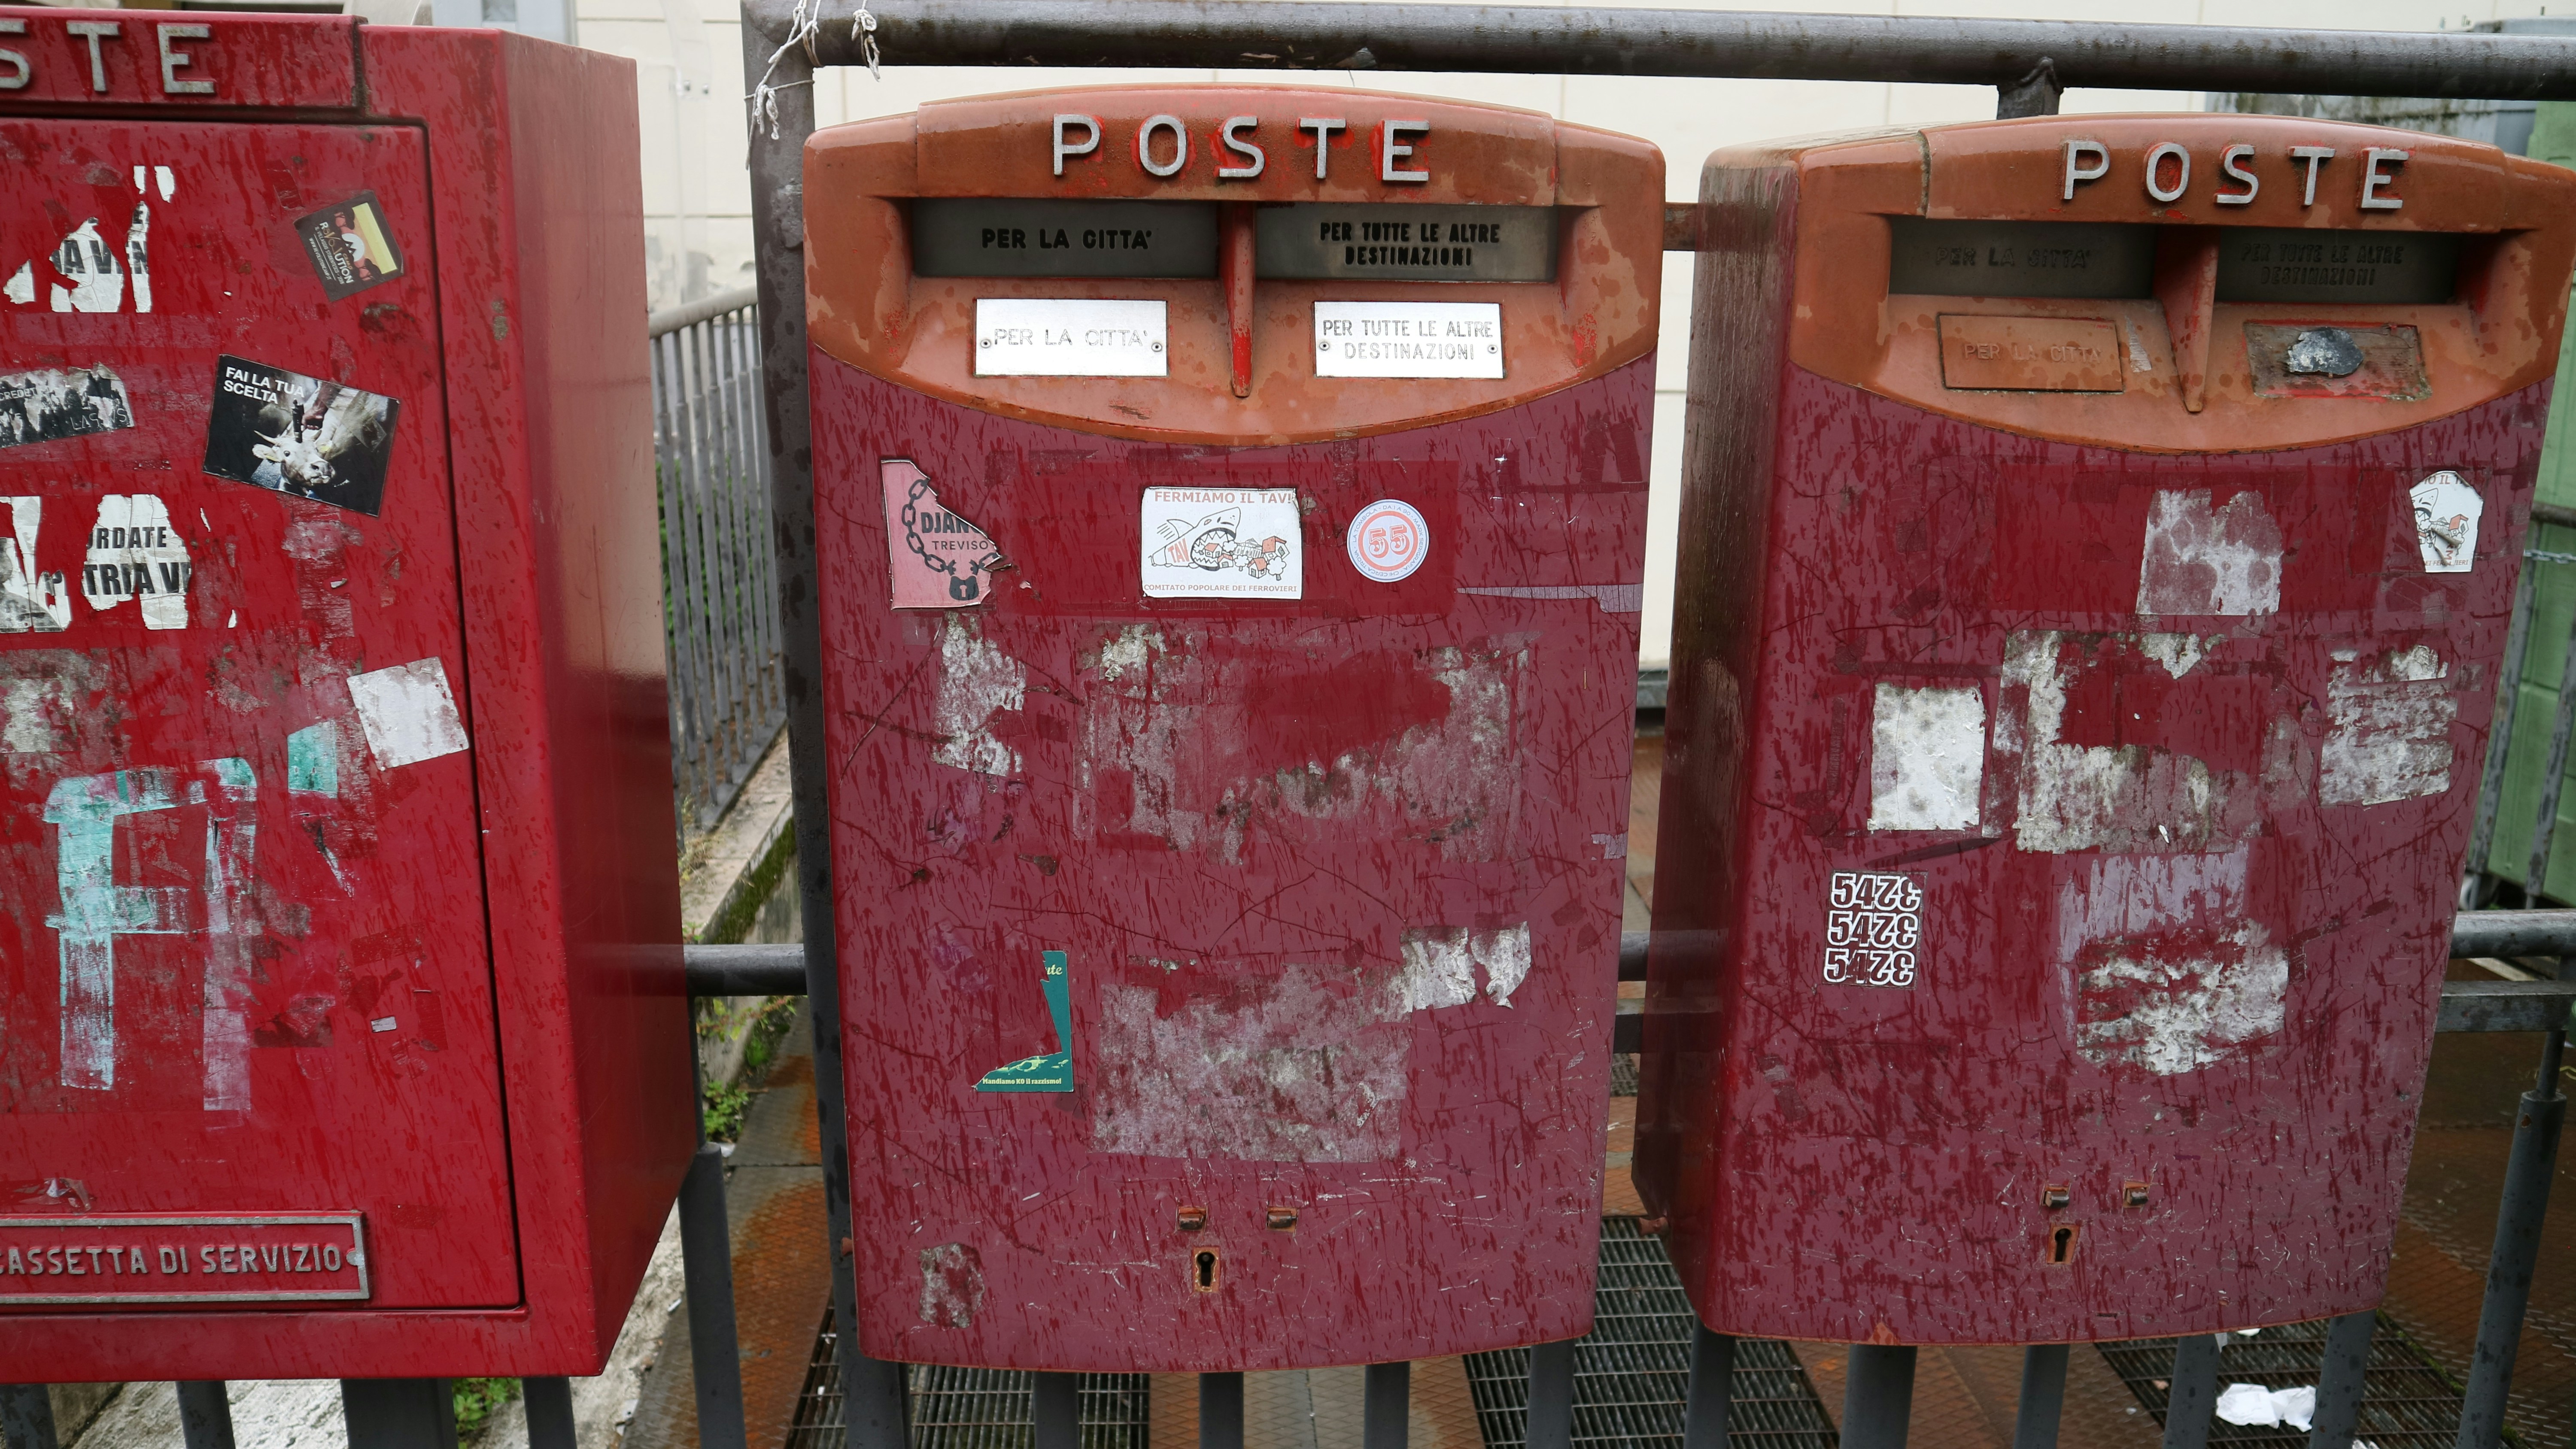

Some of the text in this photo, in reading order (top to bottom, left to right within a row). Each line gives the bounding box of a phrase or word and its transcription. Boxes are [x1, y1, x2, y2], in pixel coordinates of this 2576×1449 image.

[1053, 114, 1430, 182] POSTE
[2062, 141, 2409, 209] POSTE
[982, 228, 1152, 250] PER LA CITTA'
[1320, 222, 1500, 243] PER TUTTE LE ALTRE
[317, 230, 328, 250] VILLAGGIO
[325, 249, 340, 274] STUDENTESCO
[1345, 246, 1472, 266] DESTINAZIONI
[1936, 247, 2090, 268] PER LA CITTA'
[2242, 243, 2404, 264] PER TUTTE LE ALTRE
[2261, 267, 2376, 285] DESTINAZIONI
[994, 329, 1148, 346] PER LA CITTA'
[1323, 320, 1493, 338] PER TUTTE LE ALTRE
[1345, 343, 1474, 360] DESTINAZIONI
[1963, 343, 2001, 360] PER
[2012, 343, 2037, 361] LA
[223, 380, 278, 404] SCELTA
[226, 367, 305, 398] FAI LA TUA
[2439, 475, 2451, 485] IL
[1154, 491, 1291, 504] FERMIAMO IL TAV!
[921, 512, 981, 534] DJAN
[1354, 508, 1378, 532] TOMBOLA
[1413, 518, 1423, 536] MARK
[932, 540, 988, 550] TREVISO
[1168, 538, 1191, 564] TAV
[1368, 524, 1410, 558] 55
[1355, 549, 1366, 569] TROVA
[1403, 537, 1424, 570] SERIGRAFIA
[1368, 567, 1388, 577] CERCA
[0, 1246, 341, 1275] ASSETTA DI SERVIZIO
